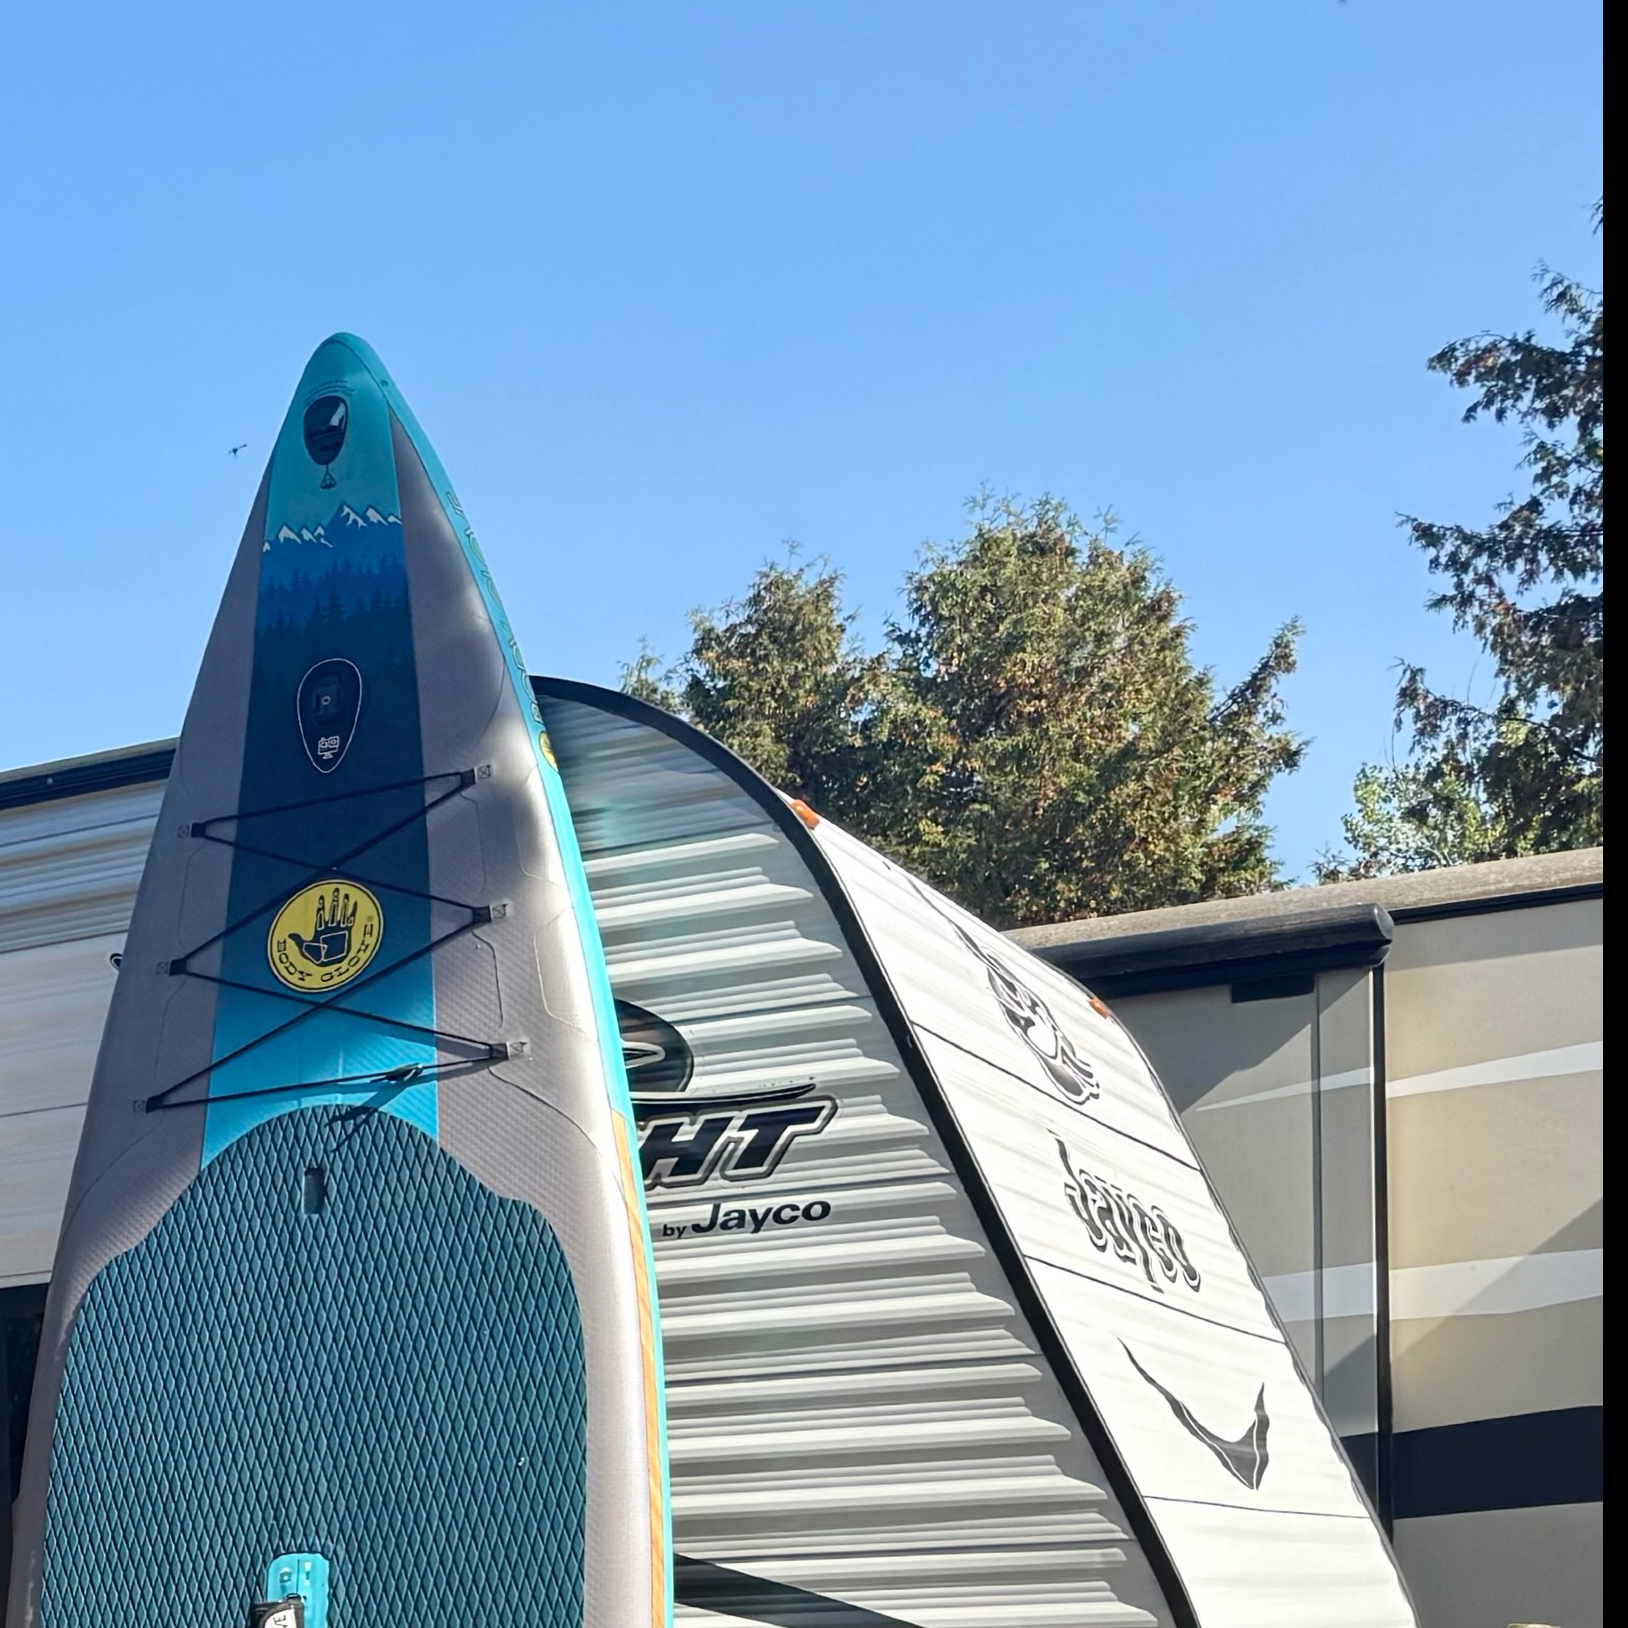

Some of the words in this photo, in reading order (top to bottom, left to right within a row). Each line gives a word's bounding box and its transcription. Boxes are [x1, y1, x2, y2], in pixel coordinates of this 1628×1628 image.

[277, 938, 313, 982] BODY
[320, 923, 374, 983] GLOVE
[662, 1223, 687, 1239] by
[691, 1200, 831, 1234] Jayco
[1046, 1129, 1201, 1293] Jayco
